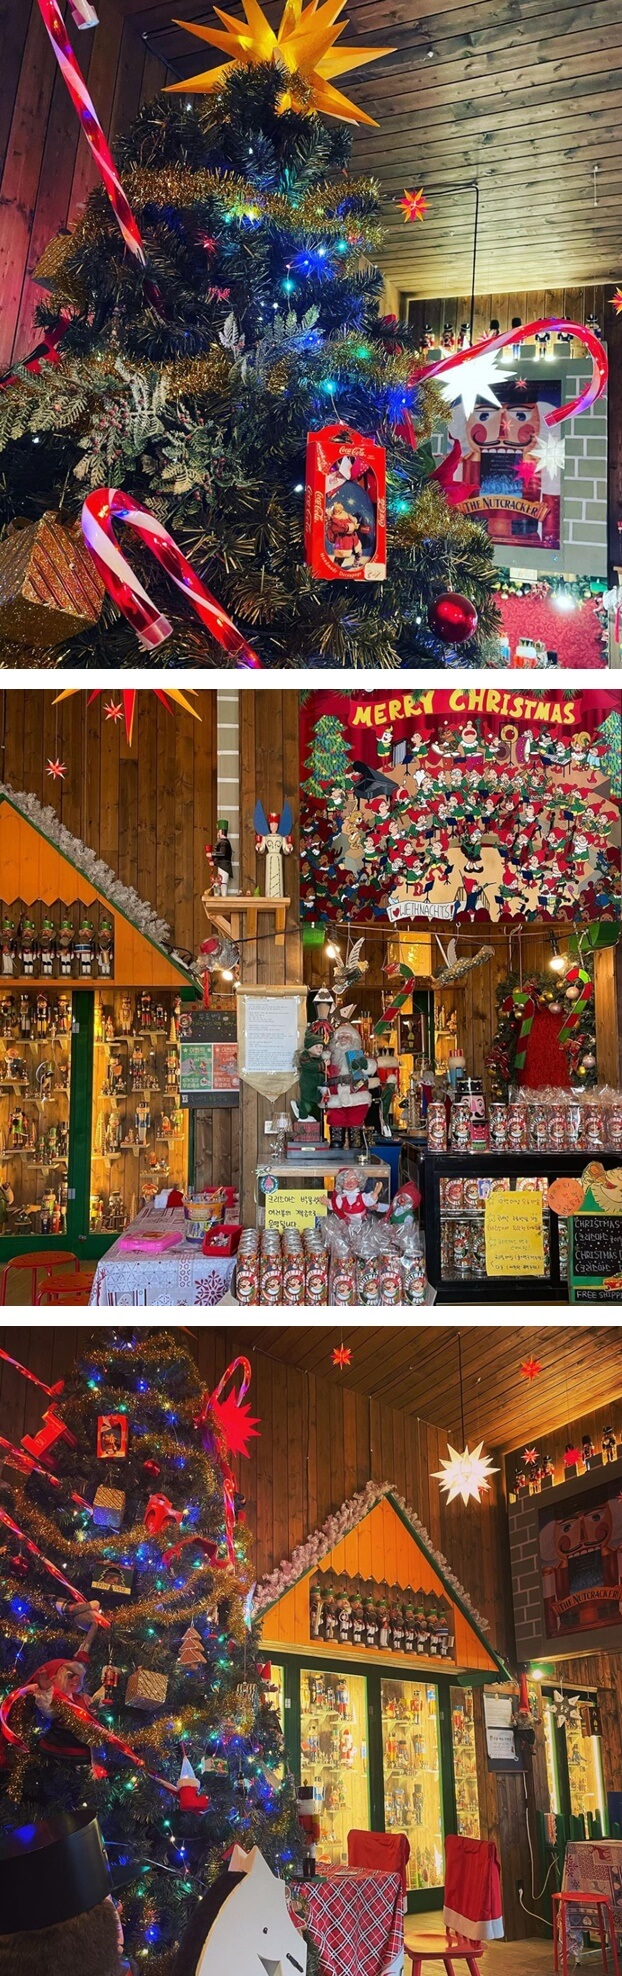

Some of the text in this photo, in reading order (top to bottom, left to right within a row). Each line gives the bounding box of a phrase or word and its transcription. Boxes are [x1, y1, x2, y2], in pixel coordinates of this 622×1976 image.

[464, 498, 539, 516] THE NUTCRACKER
[352, 690, 576, 726] MERRY CHRISTMAS
[575, 1220, 620, 1228] CHRISTMAS
[575, 1250, 618, 1260] CHRISTMAS
[576, 1290, 598, 1298] FREE
[559, 1590, 618, 1610] THE NUTCRACKER
